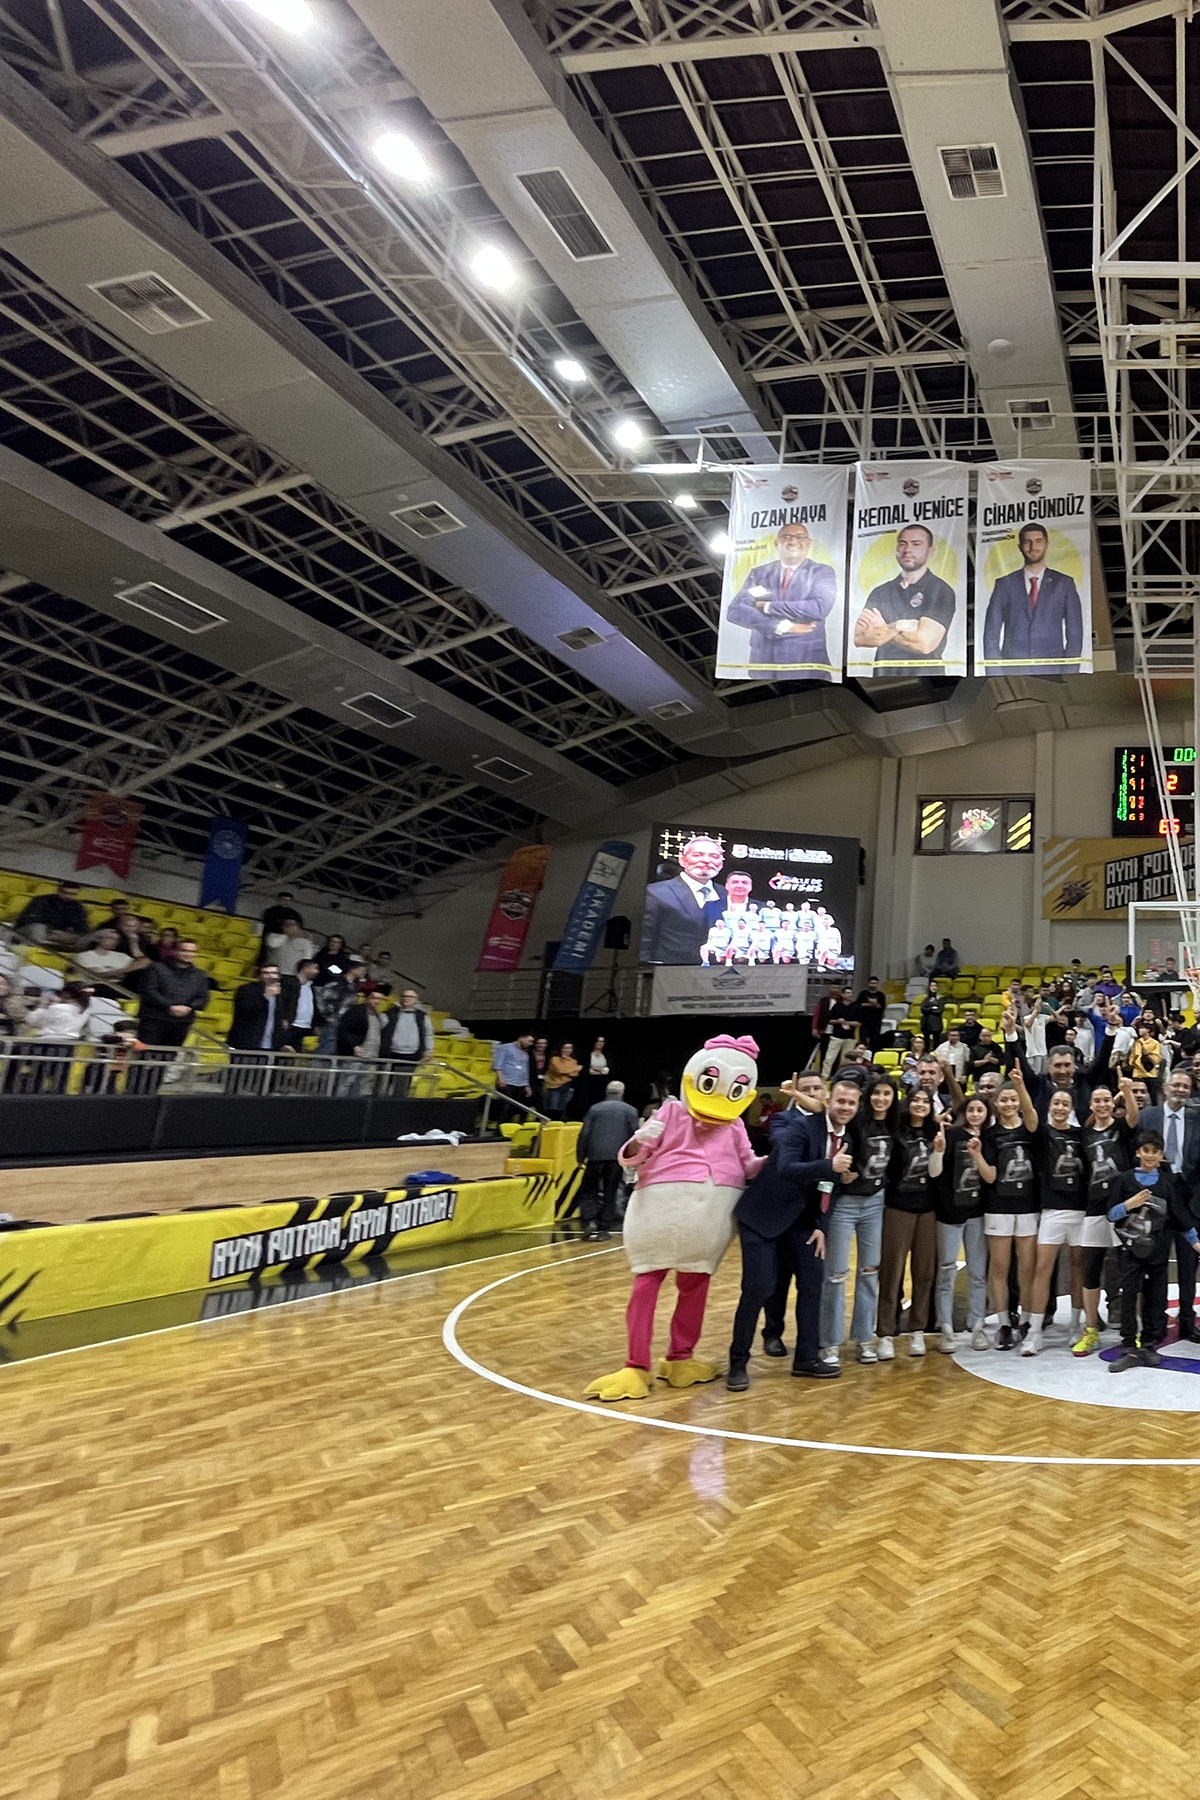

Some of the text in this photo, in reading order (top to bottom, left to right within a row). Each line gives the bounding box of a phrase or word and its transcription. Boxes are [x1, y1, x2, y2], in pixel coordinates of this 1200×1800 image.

[751, 504, 827, 529] OZAN KAYA
[858, 495, 964, 529] KEMAL YENİCE
[983, 493, 1085, 527] CİHAN GÜNDÜZ
[1166, 774, 1178, 791] 2
[962, 808, 992, 822] MSK
[1106, 844, 1195, 885] AYNI POTDA
[1106, 881, 1138, 909] AYNI
[211, 1234, 264, 1279] AYNI
